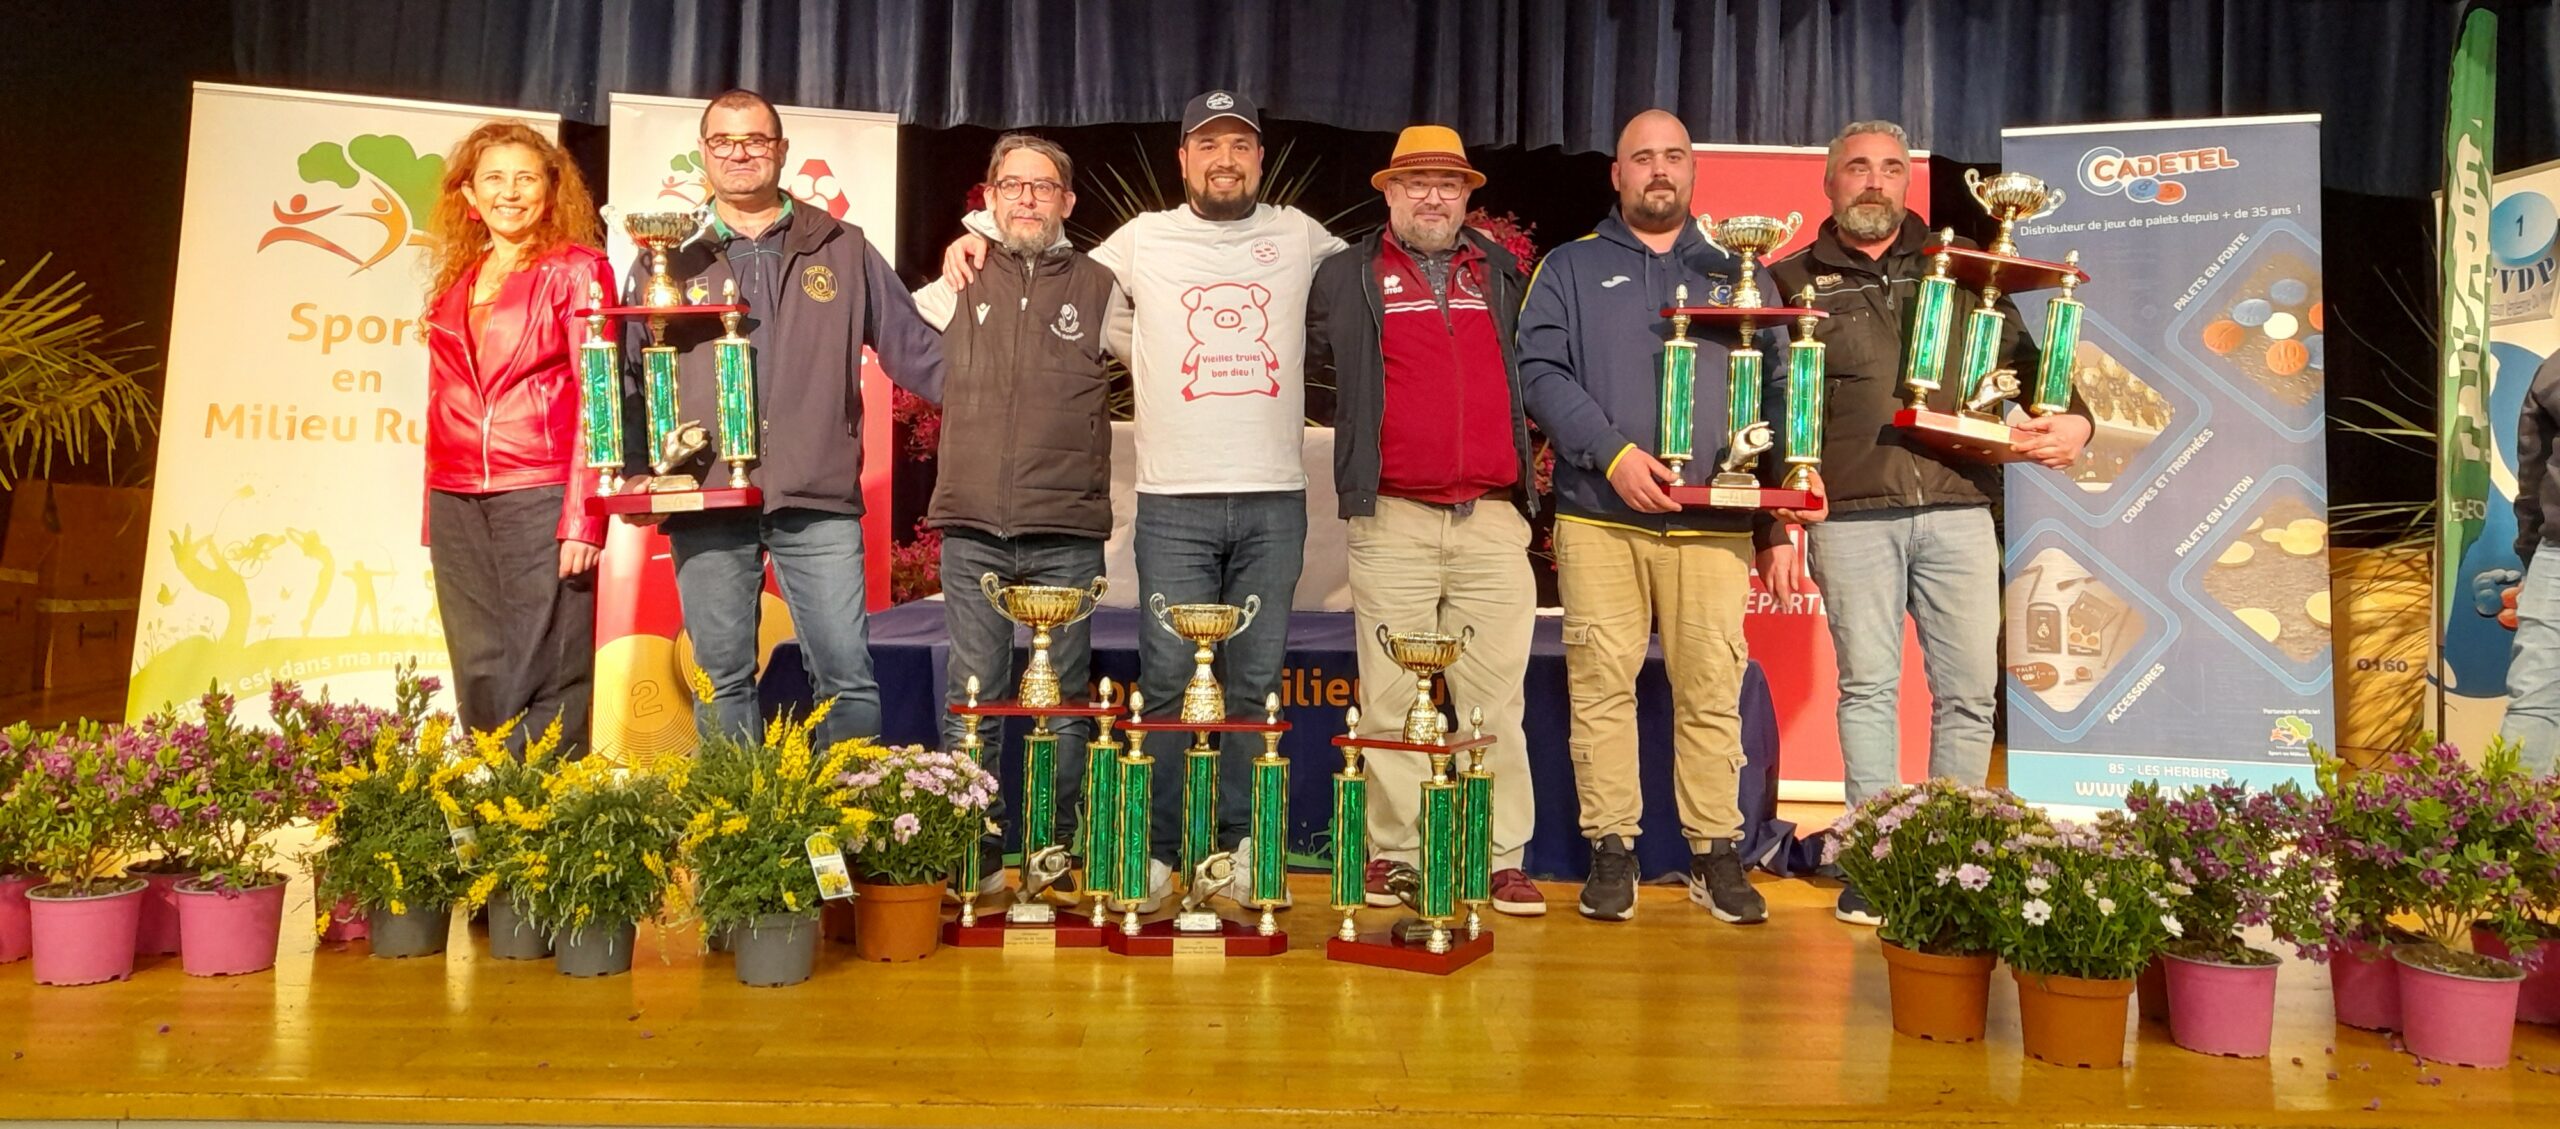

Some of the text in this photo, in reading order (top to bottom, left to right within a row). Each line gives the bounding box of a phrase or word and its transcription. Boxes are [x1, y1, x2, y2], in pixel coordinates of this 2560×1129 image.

[2093, 147, 2239, 183] CADETEL
[2020, 204, 2302, 236] Distributeur de jeux de palets depuis + de 35 ans !
[2515, 214, 2524, 237] 1
[2173, 232, 2250, 312] PALETS EN FONTE
[2493, 256, 2556, 295] VDP
[288, 302, 414, 355] Spor
[1202, 353, 1260, 363] Vieilles truies
[1211, 369, 1228, 378] bon
[1230, 368, 1249, 377] dieu
[332, 368, 382, 393] en
[204, 403, 425, 445] Milieu Ru
[2121, 428, 2214, 524] COUPES ET TROPHÉES
[2174, 475, 2255, 557] PALETS EN LAITON
[239, 666, 271, 691] est
[278, 658, 332, 679] dans
[339, 650, 371, 667] ma
[1282, 667, 1360, 707] ilie
[631, 680, 663, 718] 2
[2106, 662, 2165, 724] ACCESSOIRES
[2108, 763, 2125, 774] 85
[2137, 764, 2160, 776] LES
[2164, 765, 2229, 779] HERBIERS
